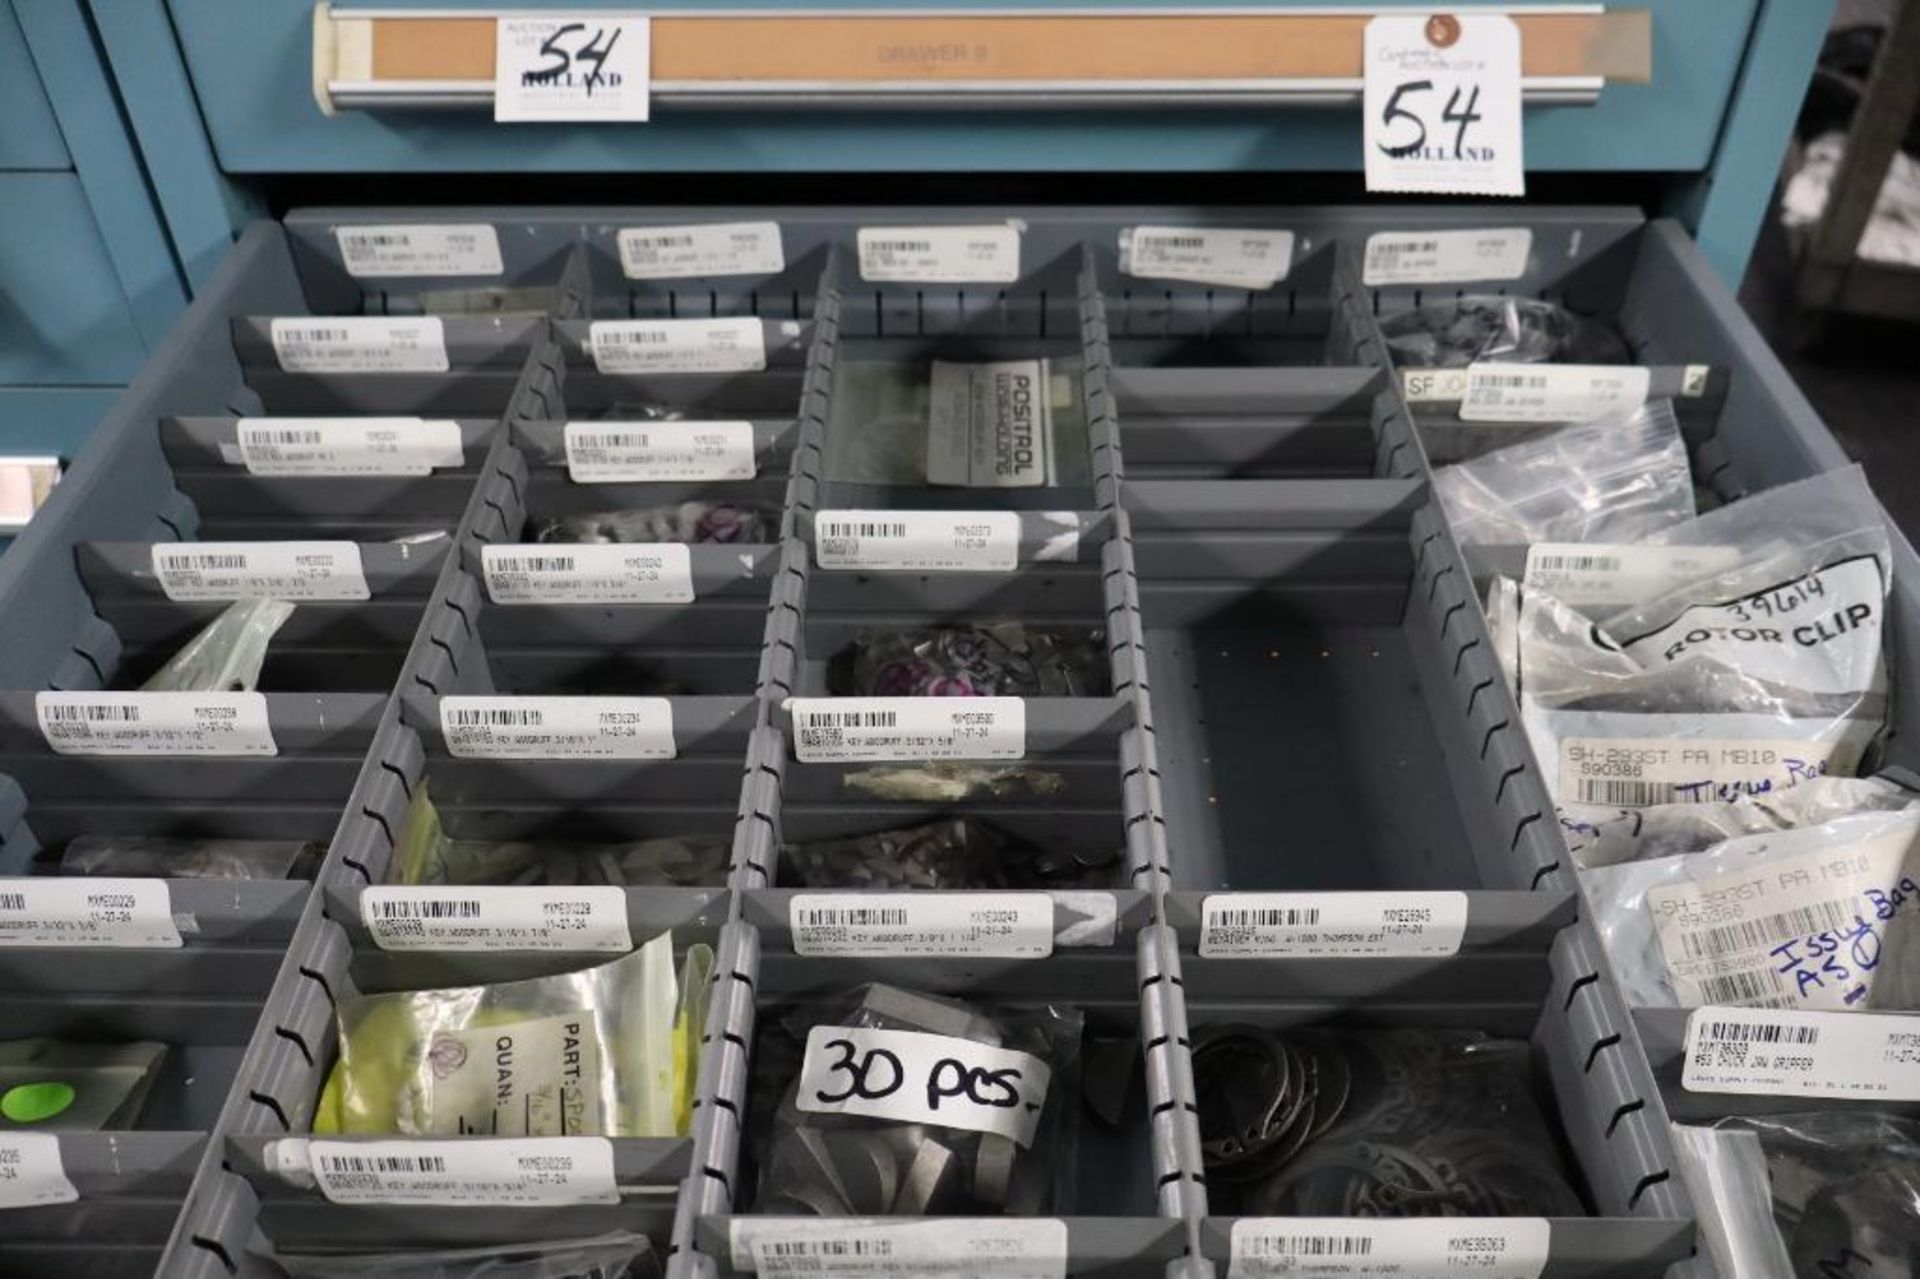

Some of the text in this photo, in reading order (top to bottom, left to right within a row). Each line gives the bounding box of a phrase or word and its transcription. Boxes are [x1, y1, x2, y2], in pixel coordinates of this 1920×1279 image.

[525, 23, 622, 98] 54
[1377, 80, 1481, 162] 54
[1409, 377, 1434, 396] SF
[1013, 374, 1032, 475] POSITROL
[1664, 603, 1872, 661] ROTOR CLIP
[90, 911, 132, 923] 11-27-24
[546, 918, 587, 929] 11-27-24
[496, 1036, 513, 1106] QUAN:
[563, 1023, 580, 1086] PART:
[816, 1039, 1040, 1111] 30 pcs.
[1773, 1057, 1814, 1071] GRIPPER
[1448, 1255, 1496, 1267] 11-27-24
